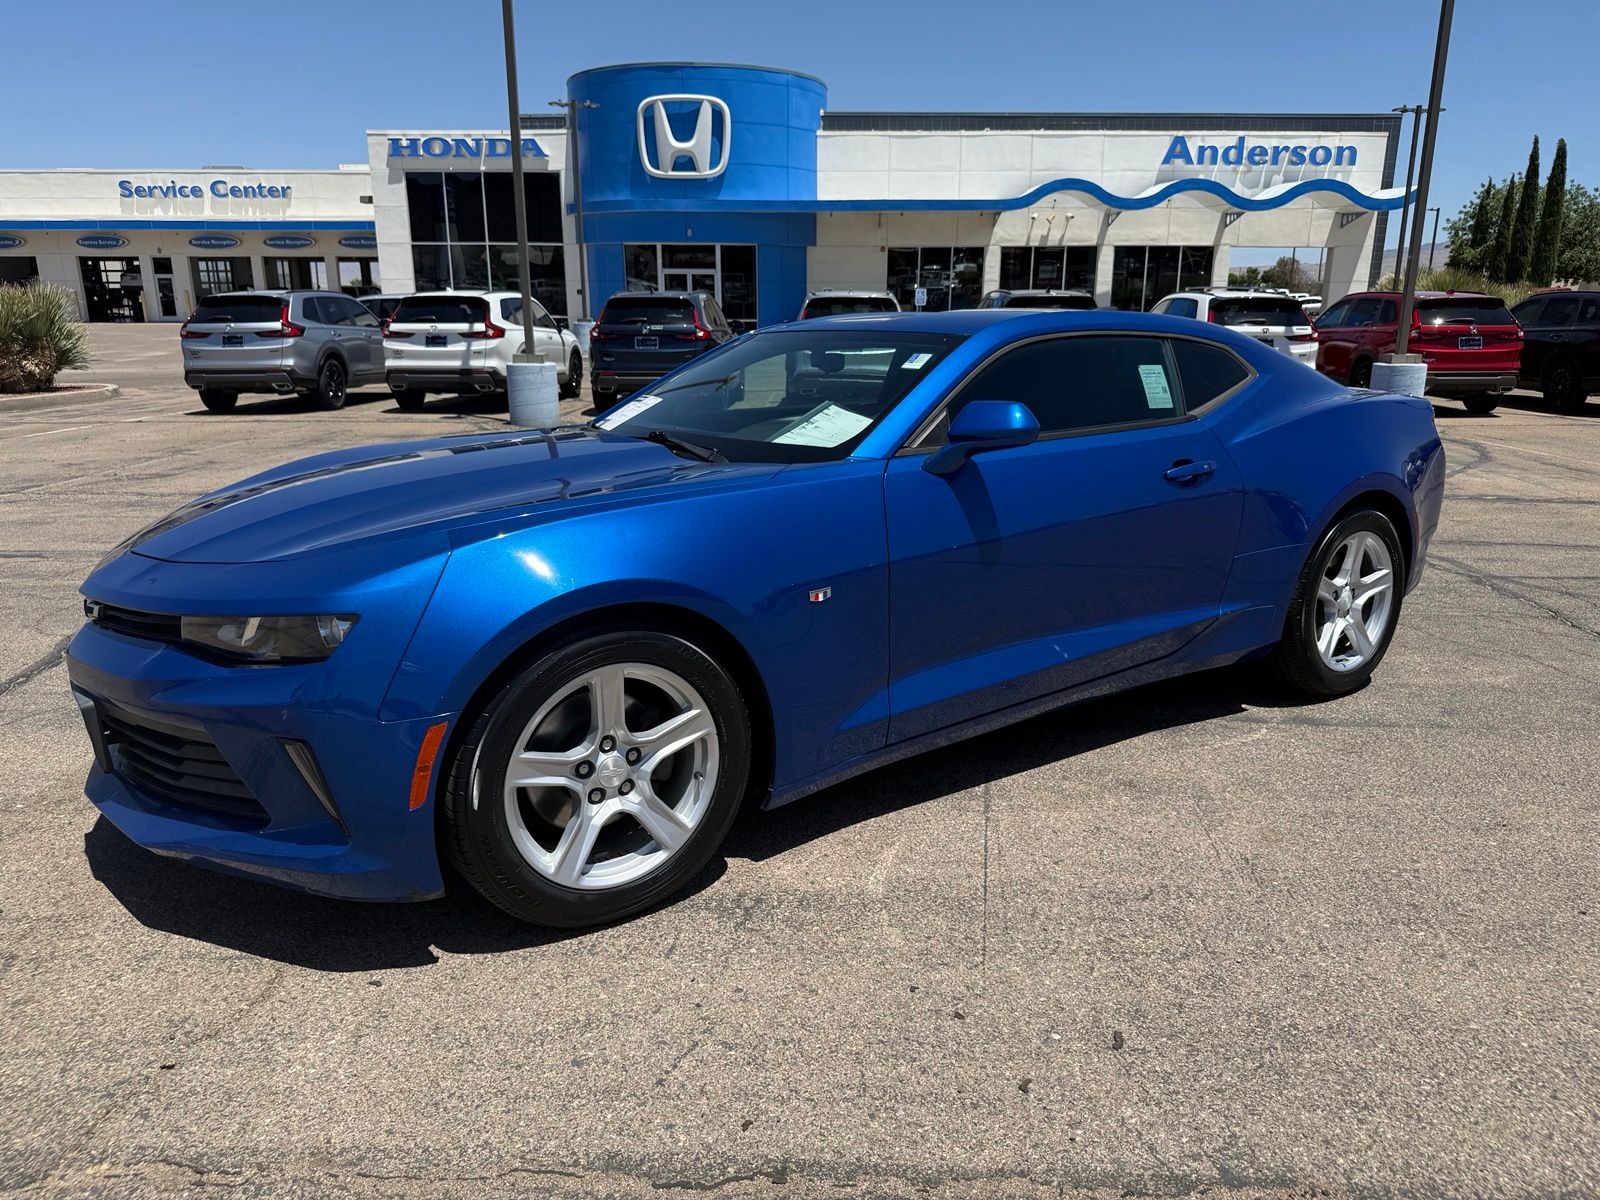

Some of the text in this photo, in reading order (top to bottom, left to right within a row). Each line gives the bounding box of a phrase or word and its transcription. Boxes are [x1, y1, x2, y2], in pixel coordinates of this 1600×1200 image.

[387, 137, 549, 158] HONDA
[1161, 135, 1358, 166] Anderson
[118, 180, 292, 198] Service Center
[211, 239, 237, 247] Reception
[285, 239, 312, 247] Reception
